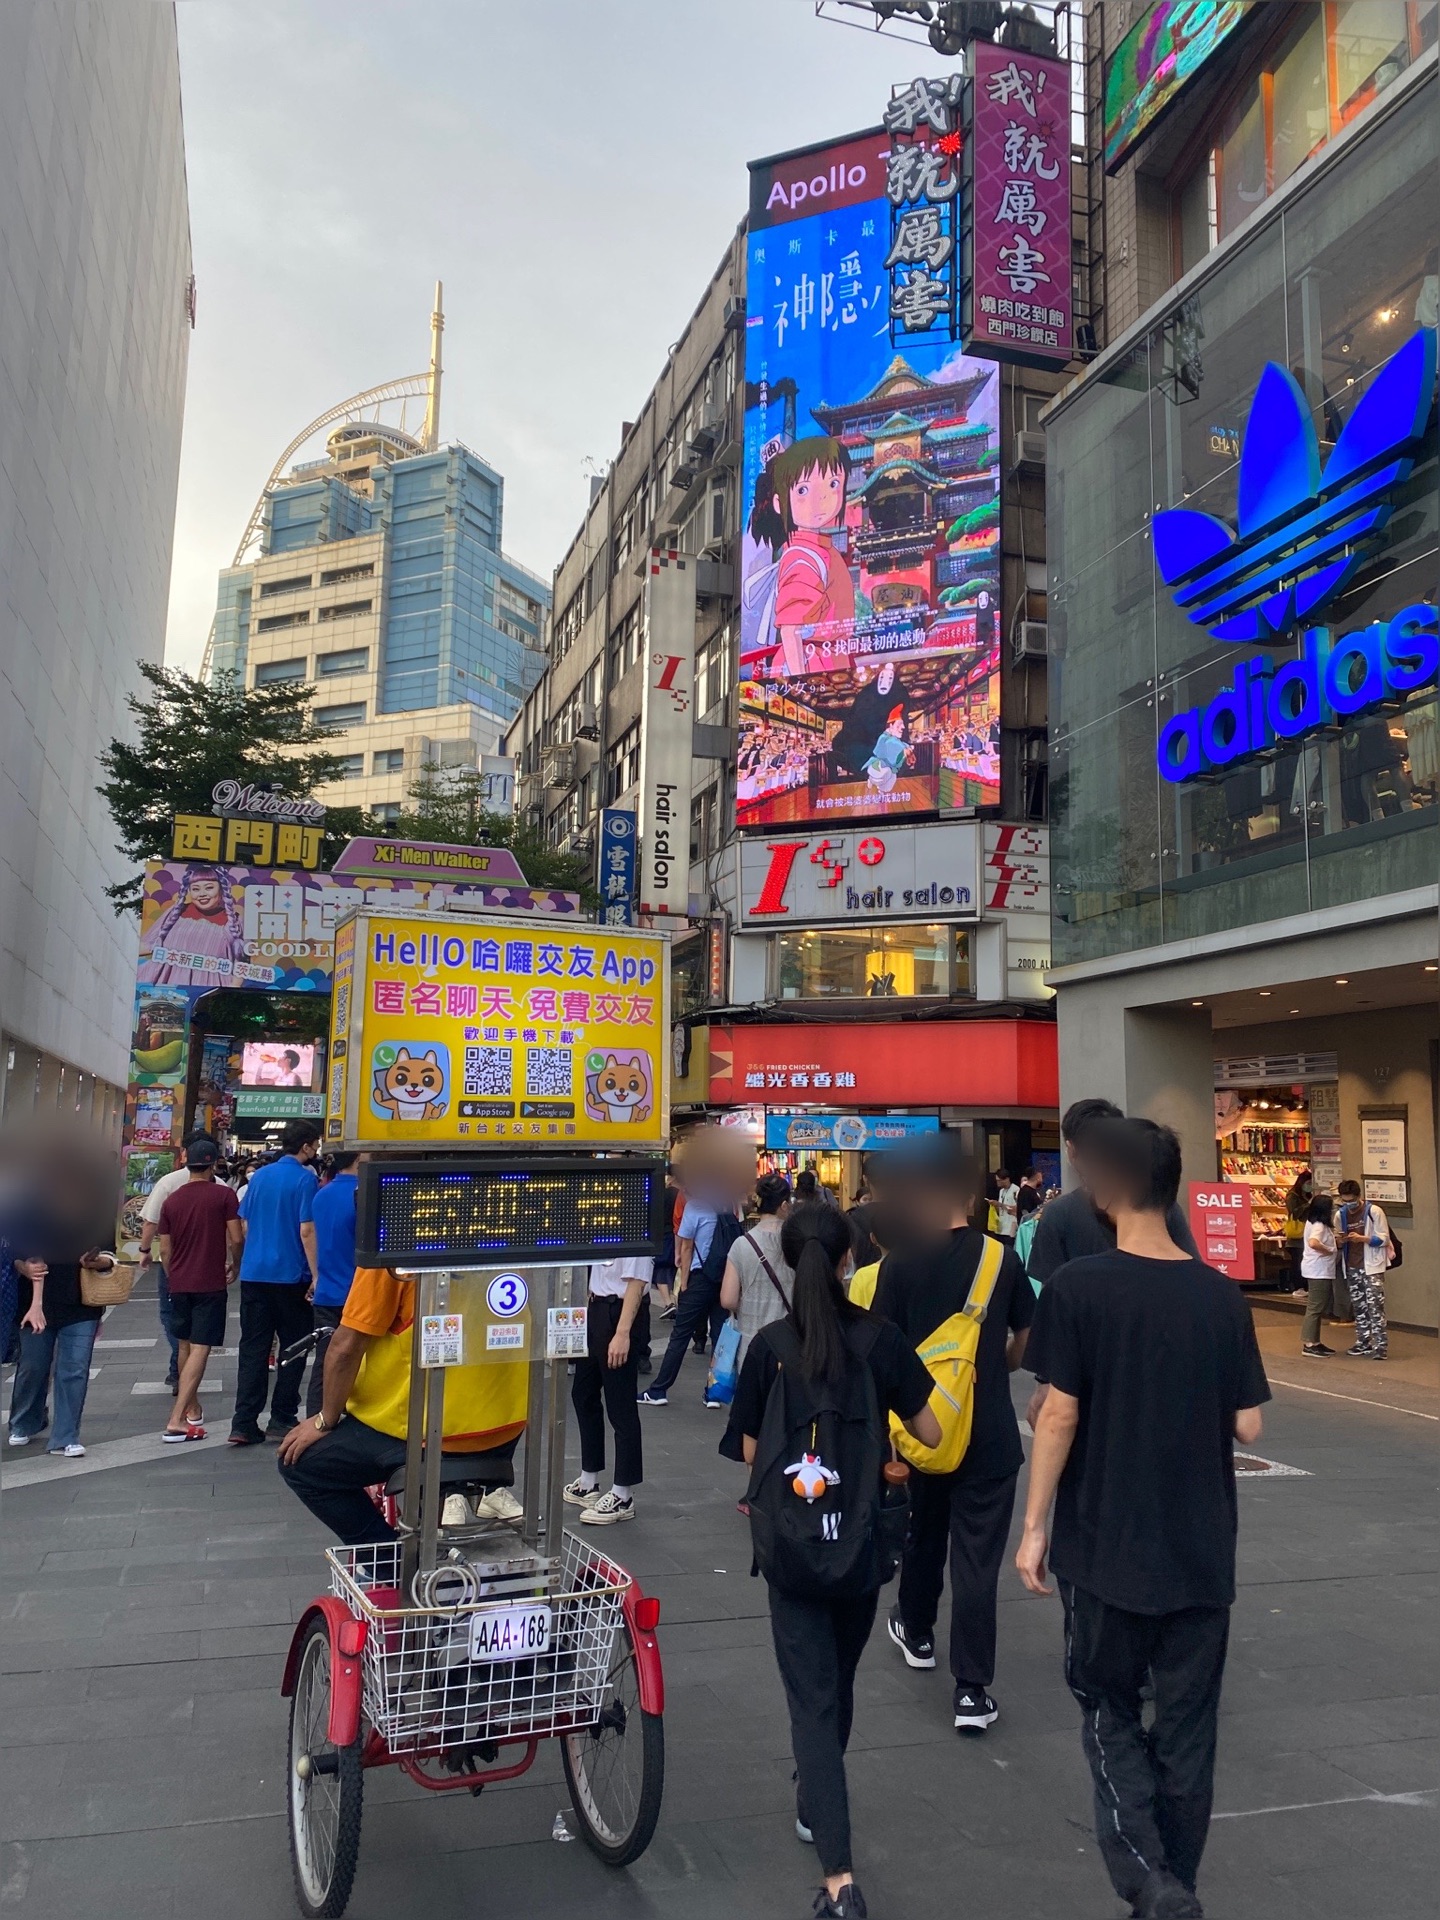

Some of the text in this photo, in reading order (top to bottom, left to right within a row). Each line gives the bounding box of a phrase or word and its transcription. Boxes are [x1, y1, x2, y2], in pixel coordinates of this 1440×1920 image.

[766, 164, 866, 209] Apollo
[980, 295, 1064, 328] 燒肉吃到飽
[1158, 604, 1440, 783] adidas
[212, 780, 326, 818] Welcome
[173, 814, 325, 869] 西門町
[653, 784, 677, 889] hair salon
[374, 845, 489, 870] Xi-Men Walker
[846, 882, 970, 909] hair salon
[244, 942, 335, 957] GOOD LU
[471, 939, 595, 978] 哈囉交友
[601, 950, 655, 985] App
[1018, 958, 1036, 968] 2000
[152, 949, 274, 981] 日本新目的地 茨城縣
[372, 980, 655, 1026] 匿名聊天 免費交友
[464, 1026, 574, 1044] 歡迎手機下載
[745, 1072, 856, 1088] 繼光香香雞
[476, 1108, 510, 1116] App Store
[537, 1108, 558, 1117] Google
[458, 1123, 576, 1135] 新台北交友集團
[1196, 1193, 1243, 1208] SALE
[498, 1280, 518, 1310] 3
[477, 1614, 545, 1654] AAA-168
